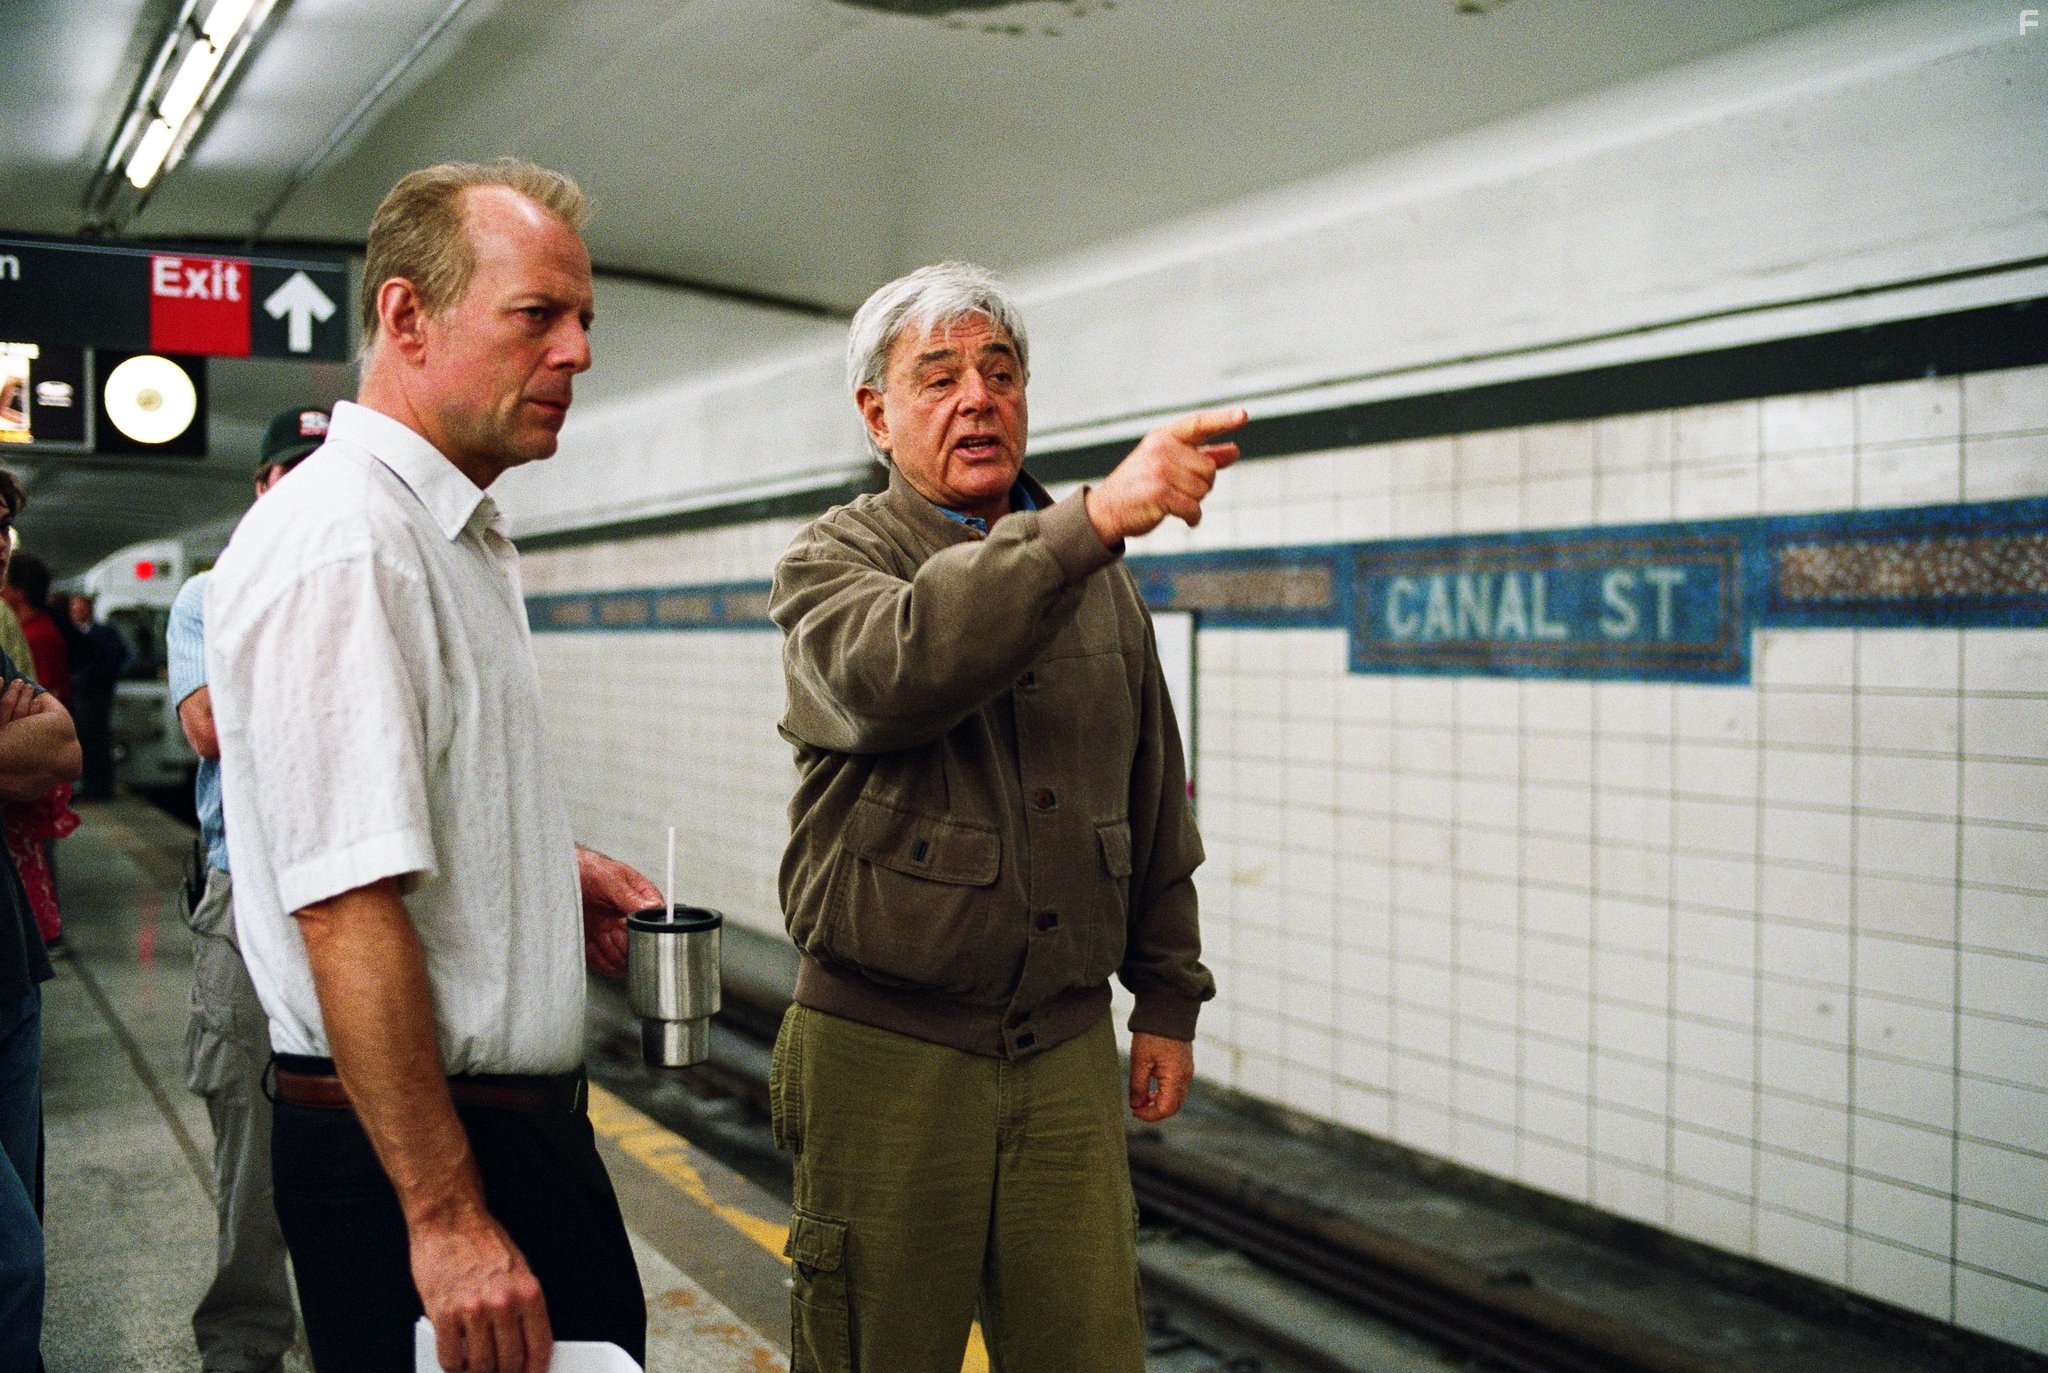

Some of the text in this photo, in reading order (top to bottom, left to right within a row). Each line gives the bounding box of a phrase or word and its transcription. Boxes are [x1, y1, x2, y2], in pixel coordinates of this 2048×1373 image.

[152, 256, 242, 303] Exit
[1385, 566, 1686, 641] CANAL ST
